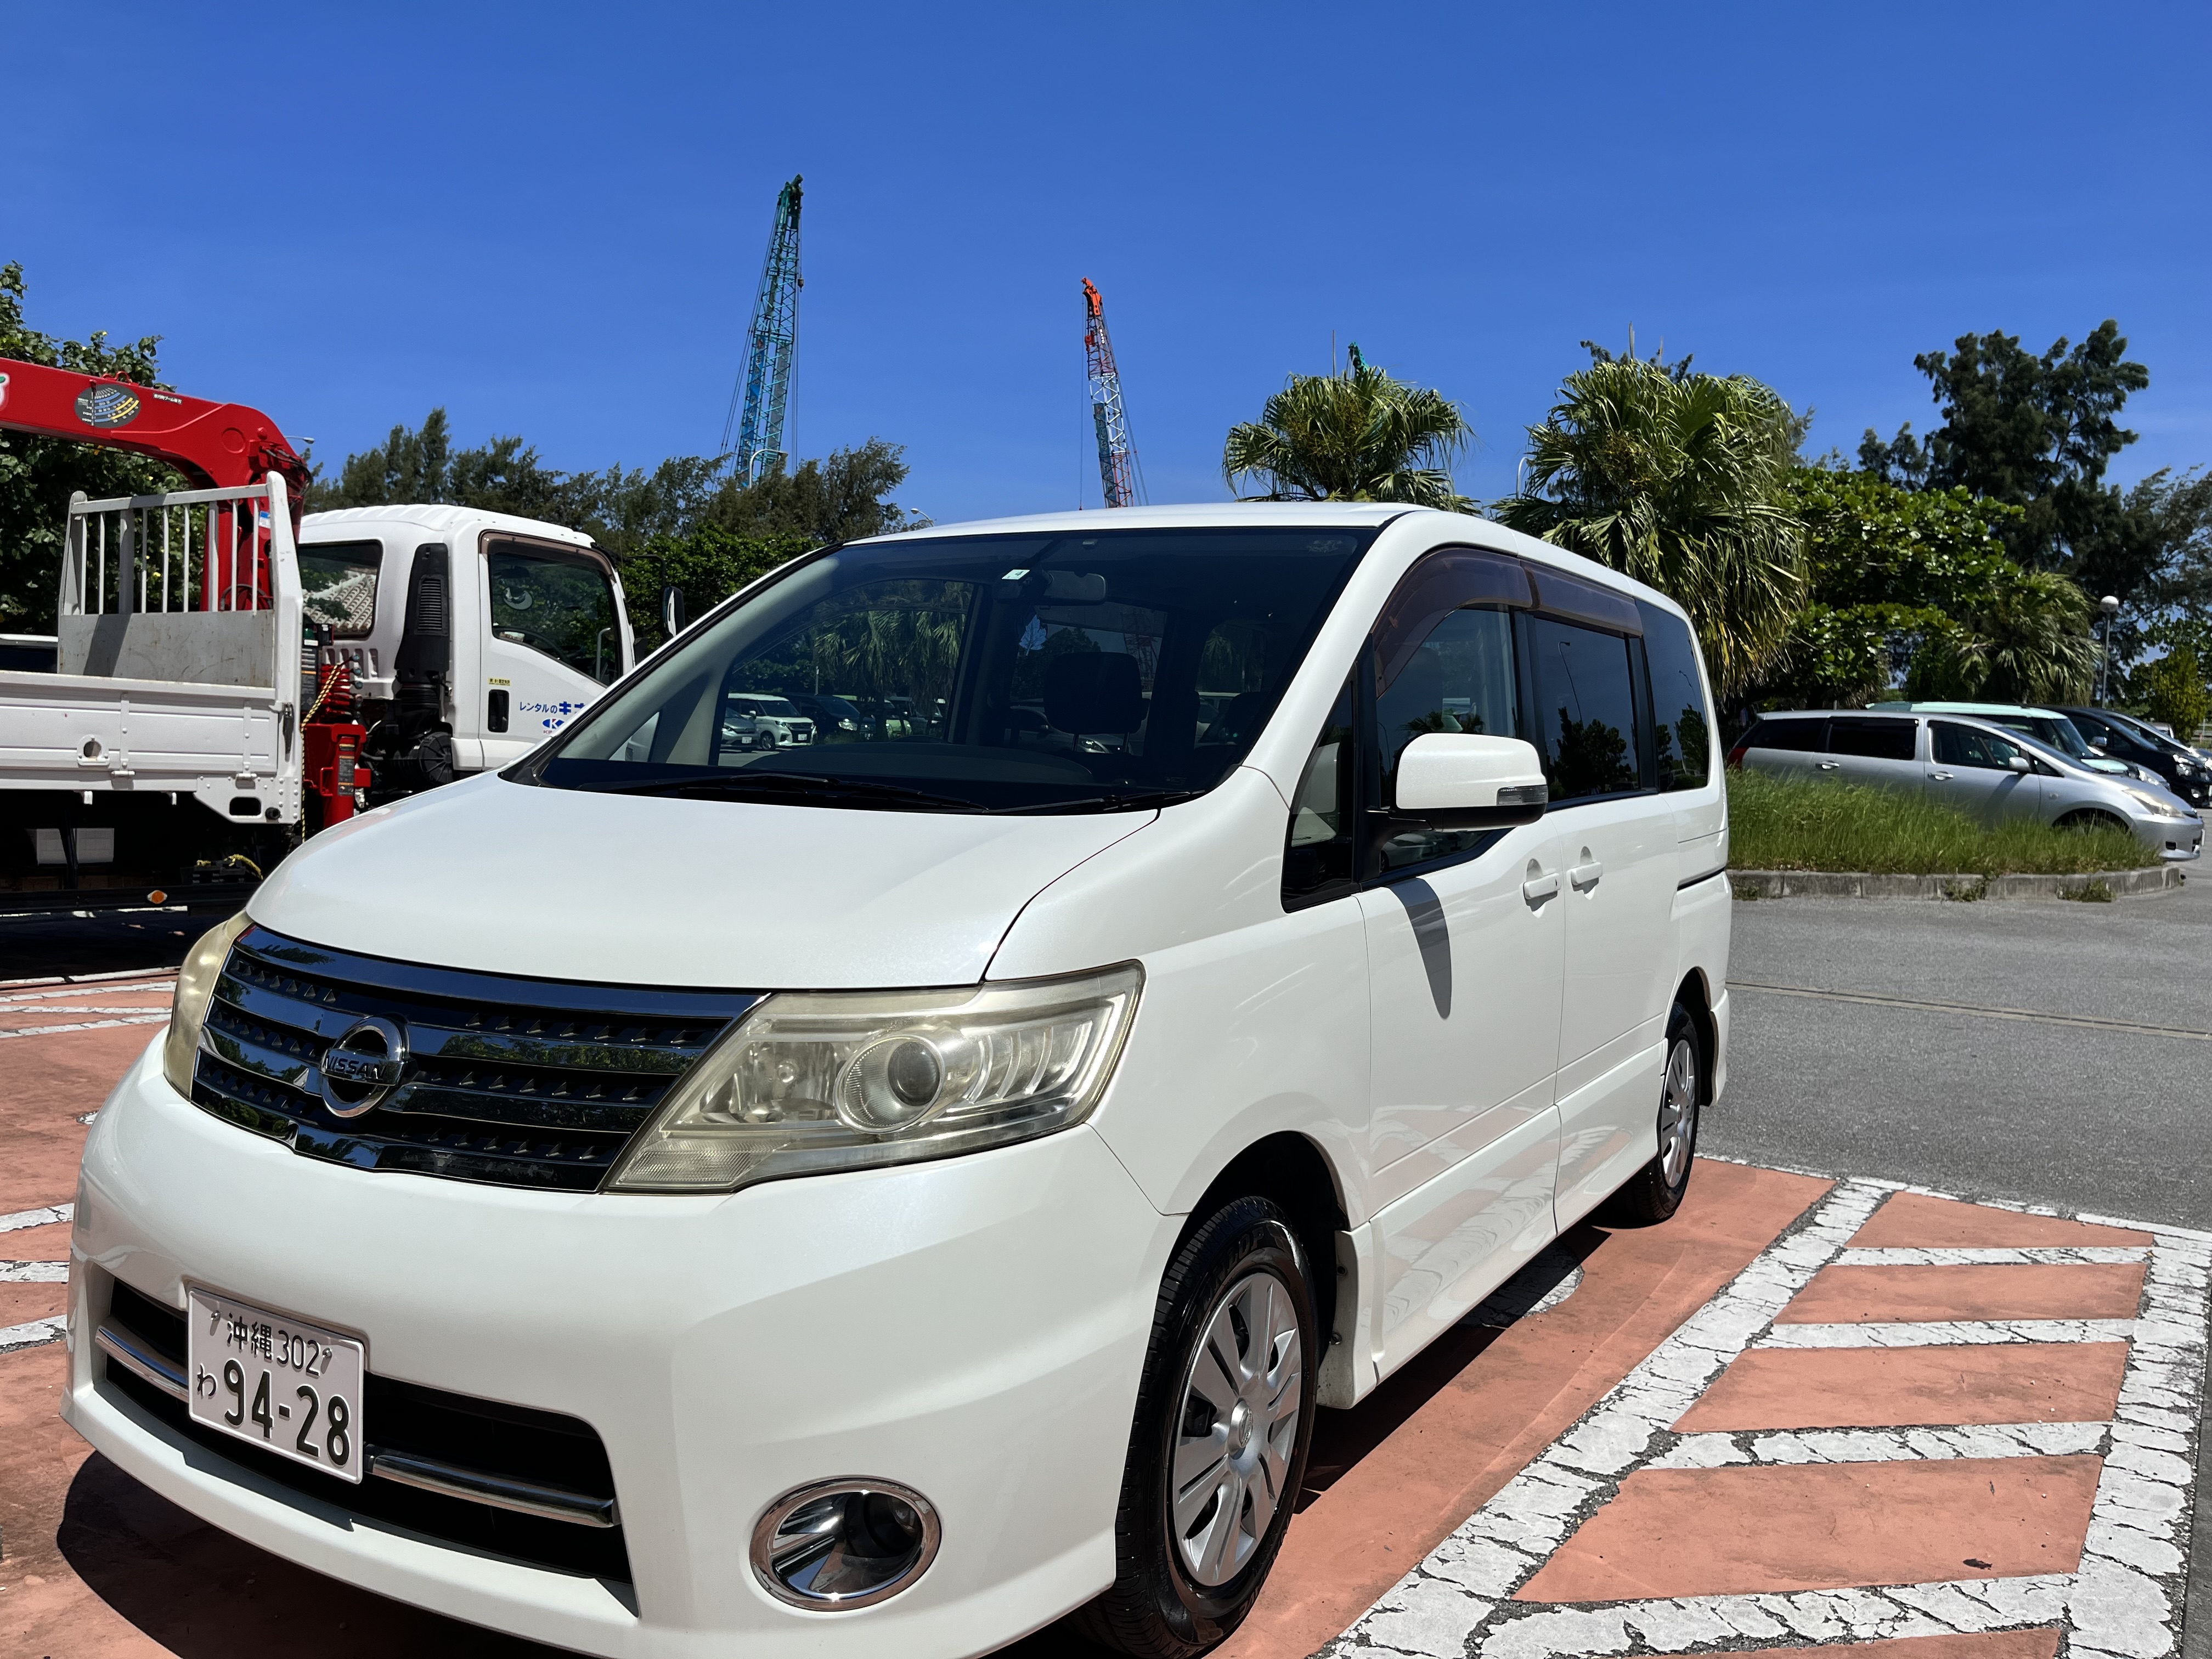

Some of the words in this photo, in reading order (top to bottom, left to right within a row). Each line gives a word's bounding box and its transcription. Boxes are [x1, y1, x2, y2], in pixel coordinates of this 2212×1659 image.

[326, 1055, 386, 1079] NISSAN
[198, 1363, 217, 1397] わ
[223, 1358, 351, 1466] 94-28
